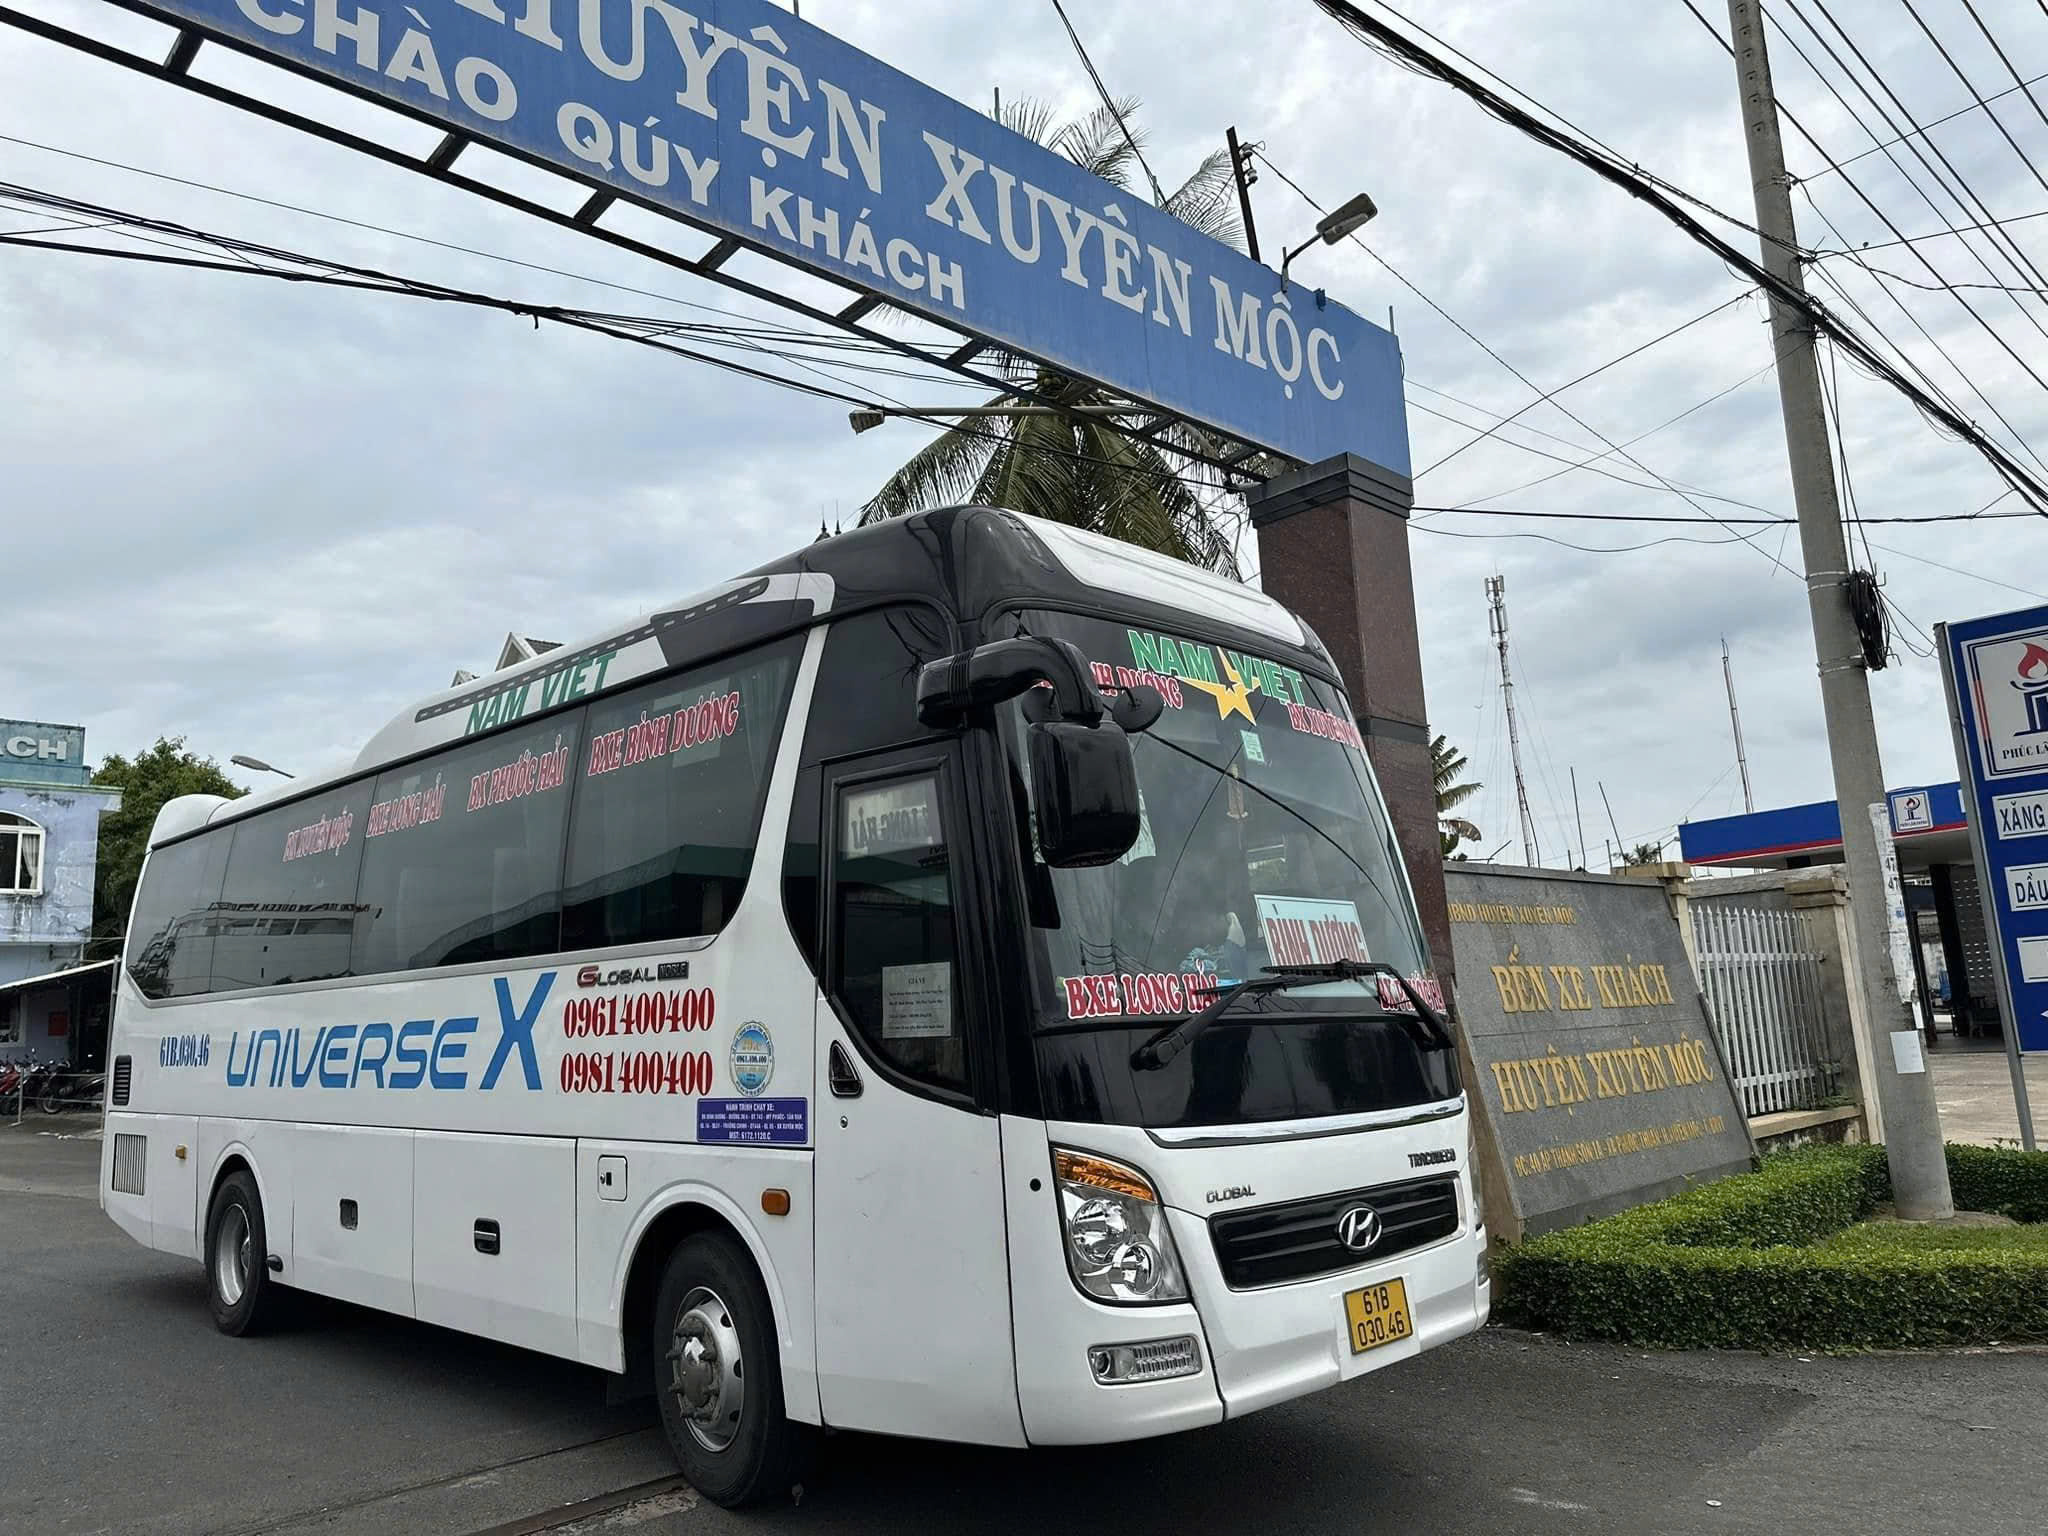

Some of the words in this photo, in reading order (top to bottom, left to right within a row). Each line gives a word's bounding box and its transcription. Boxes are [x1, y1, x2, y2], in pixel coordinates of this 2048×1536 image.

[556, 102, 721, 206] QÚY
[751, 176, 966, 311] KHÁCH
[922, 130, 1194, 338] XUYÊN
[1209, 275, 1346, 402] MỘC
[1127, 629, 1220, 685] NAM
[1228, 651, 1305, 706] VIỆT
[464, 684, 530, 736] NAM
[588, 728, 624, 776] BXE
[670, 691, 739, 753] DƯƠNG
[487, 749, 538, 806] PHƯỚC
[536, 734, 568, 792] HẢI
[2002, 744, 2033, 759] PHÚC
[2000, 801, 2045, 832] XĂNG
[2015, 871, 2048, 903] DẦU
[577, 965, 656, 988] GLOBAL
[1064, 974, 1121, 1019] BXE
[1121, 973, 1183, 1015] LONG
[1490, 944, 1552, 1014] BẾN
[1550, 965, 1592, 1011] XE
[1591, 953, 1674, 1009] KHÁCH
[226, 1017, 479, 1089] UNIVERSE
[479, 972, 558, 1090] X
[564, 987, 715, 1038] 0961400400
[561, 1051, 713, 1096] 0981400400
[1490, 1043, 1591, 1116] HUYỆN
[1586, 1036, 1671, 1099] XUYÊN
[1663, 1032, 1714, 1093] MỘC
[1206, 1185, 1256, 1203] GLOBAL
[1362, 1286, 1390, 1315] 61B
[1357, 1310, 1405, 1347] 030.46
